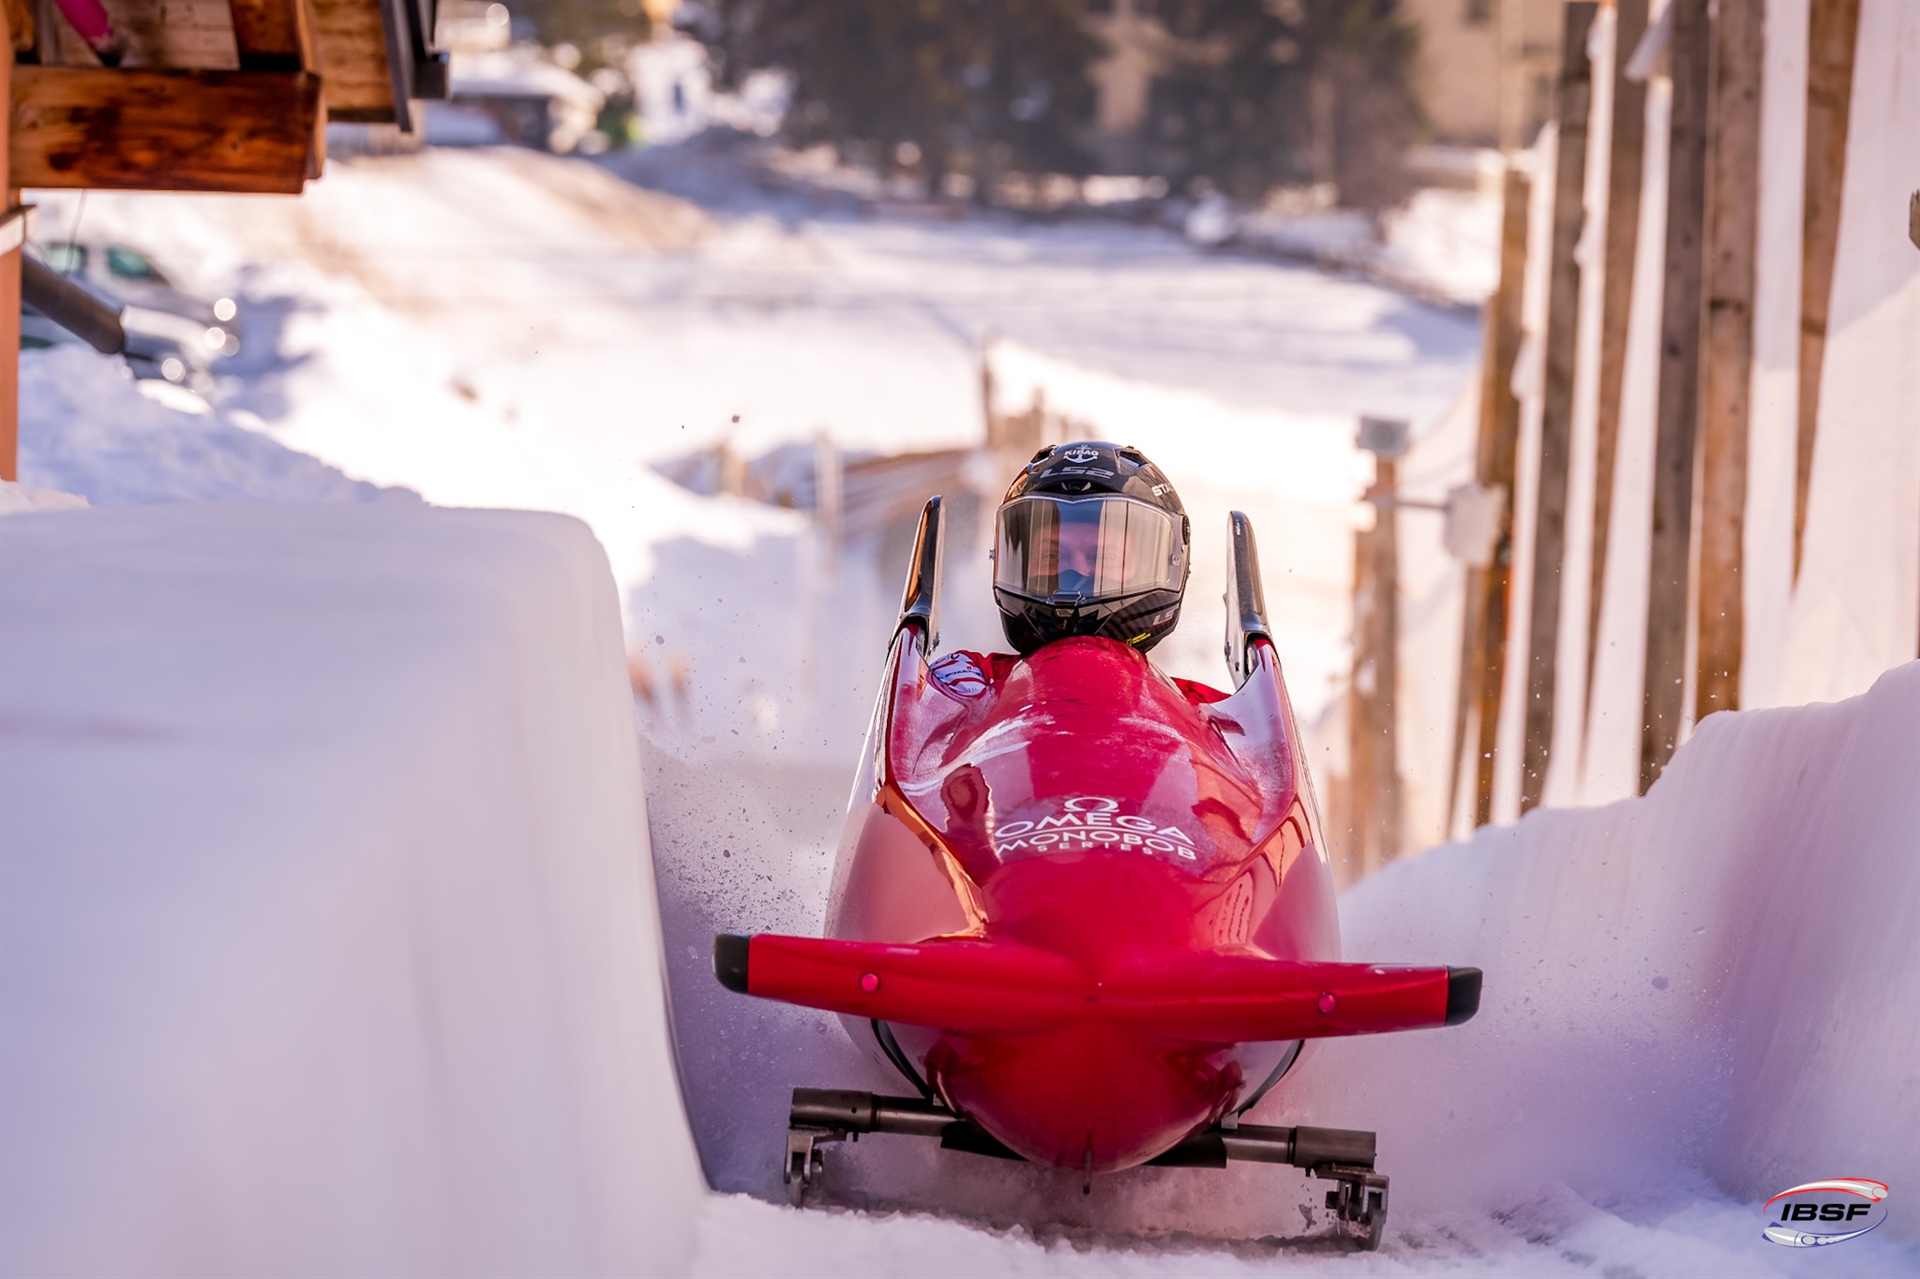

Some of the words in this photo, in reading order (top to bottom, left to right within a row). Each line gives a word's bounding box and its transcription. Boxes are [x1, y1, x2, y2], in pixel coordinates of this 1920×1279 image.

[1039, 466, 1115, 480] LS2
[994, 812, 1196, 846] OMEGA
[995, 830, 1197, 861] MONOBOB
[1037, 841, 1154, 856] SERIES
